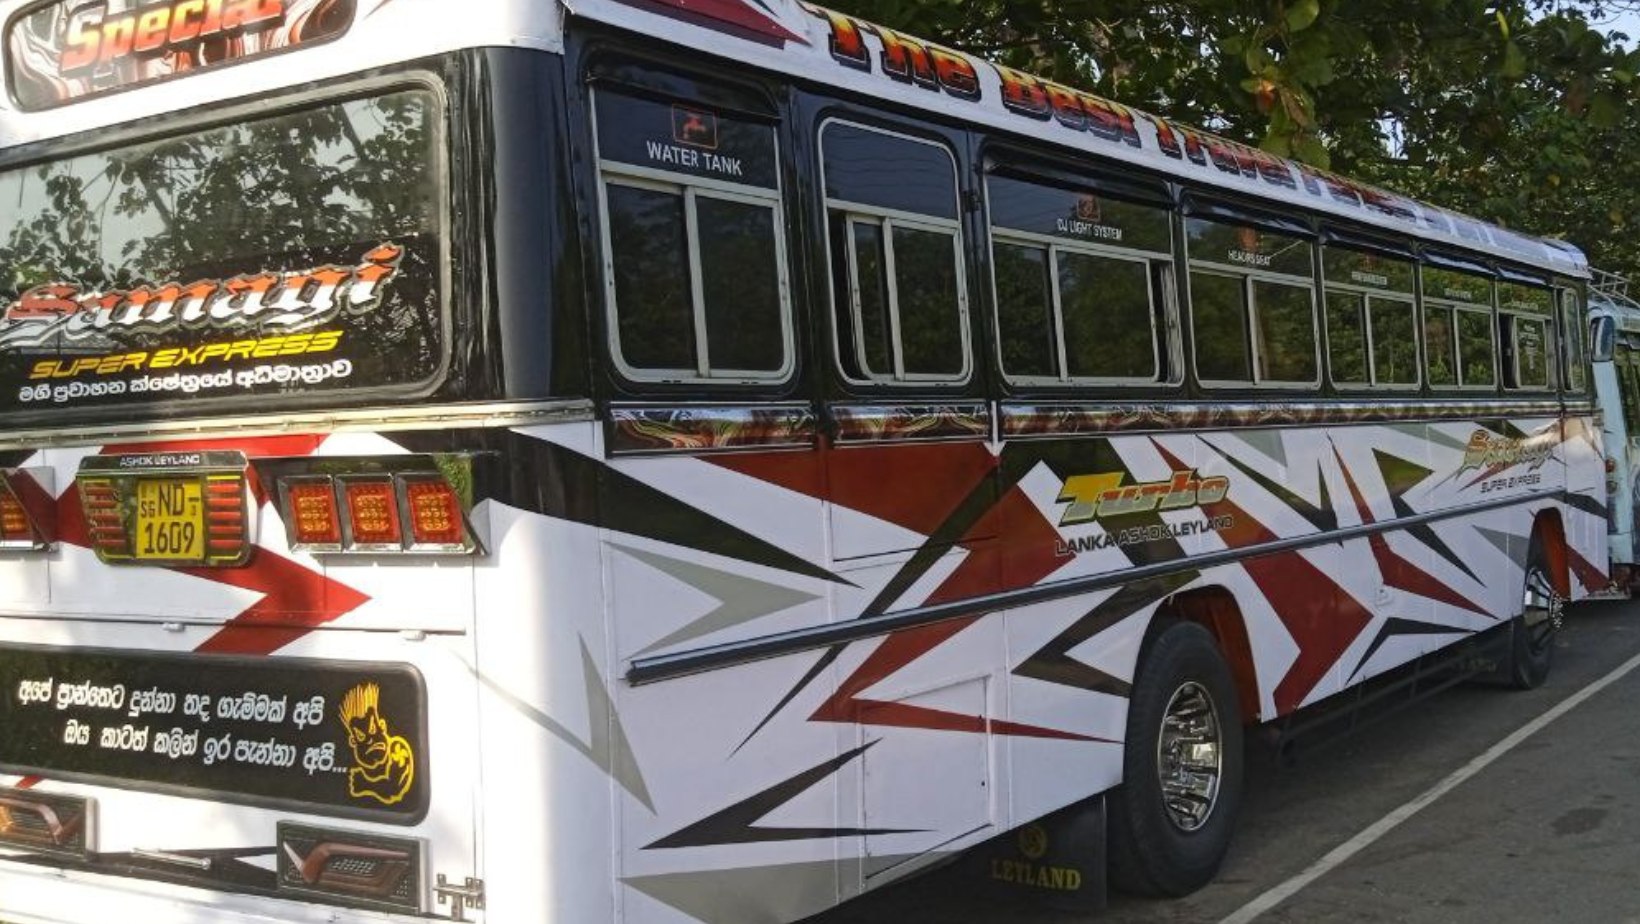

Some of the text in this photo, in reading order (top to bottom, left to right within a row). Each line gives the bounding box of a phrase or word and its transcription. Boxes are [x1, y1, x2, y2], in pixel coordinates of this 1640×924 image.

[60, 0, 283, 73] Specia
[646, 140, 743, 176] WATER TANK
[1069, 220, 1092, 236] LIGHT
[2, 243, 403, 348] Samagi
[29, 331, 343, 380] SUPER EXPRESS
[120, 454, 200, 467] ASHOK LEYLAND
[1055, 469, 1230, 527] Turbo
[143, 521, 195, 555] 1609
[1056, 514, 1233, 556] LANKA ASHOK LEYLAND
[18, 677, 53, 706] අපේ
[217, 691, 288, 723] ගැම්මක්
[292, 695, 326, 730] අපි
[101, 724, 149, 751] කාටත්
[154, 727, 199, 758] කලින්
[234, 737, 296, 768] පැන්නා
[990, 859, 1081, 890] LEYLAND
